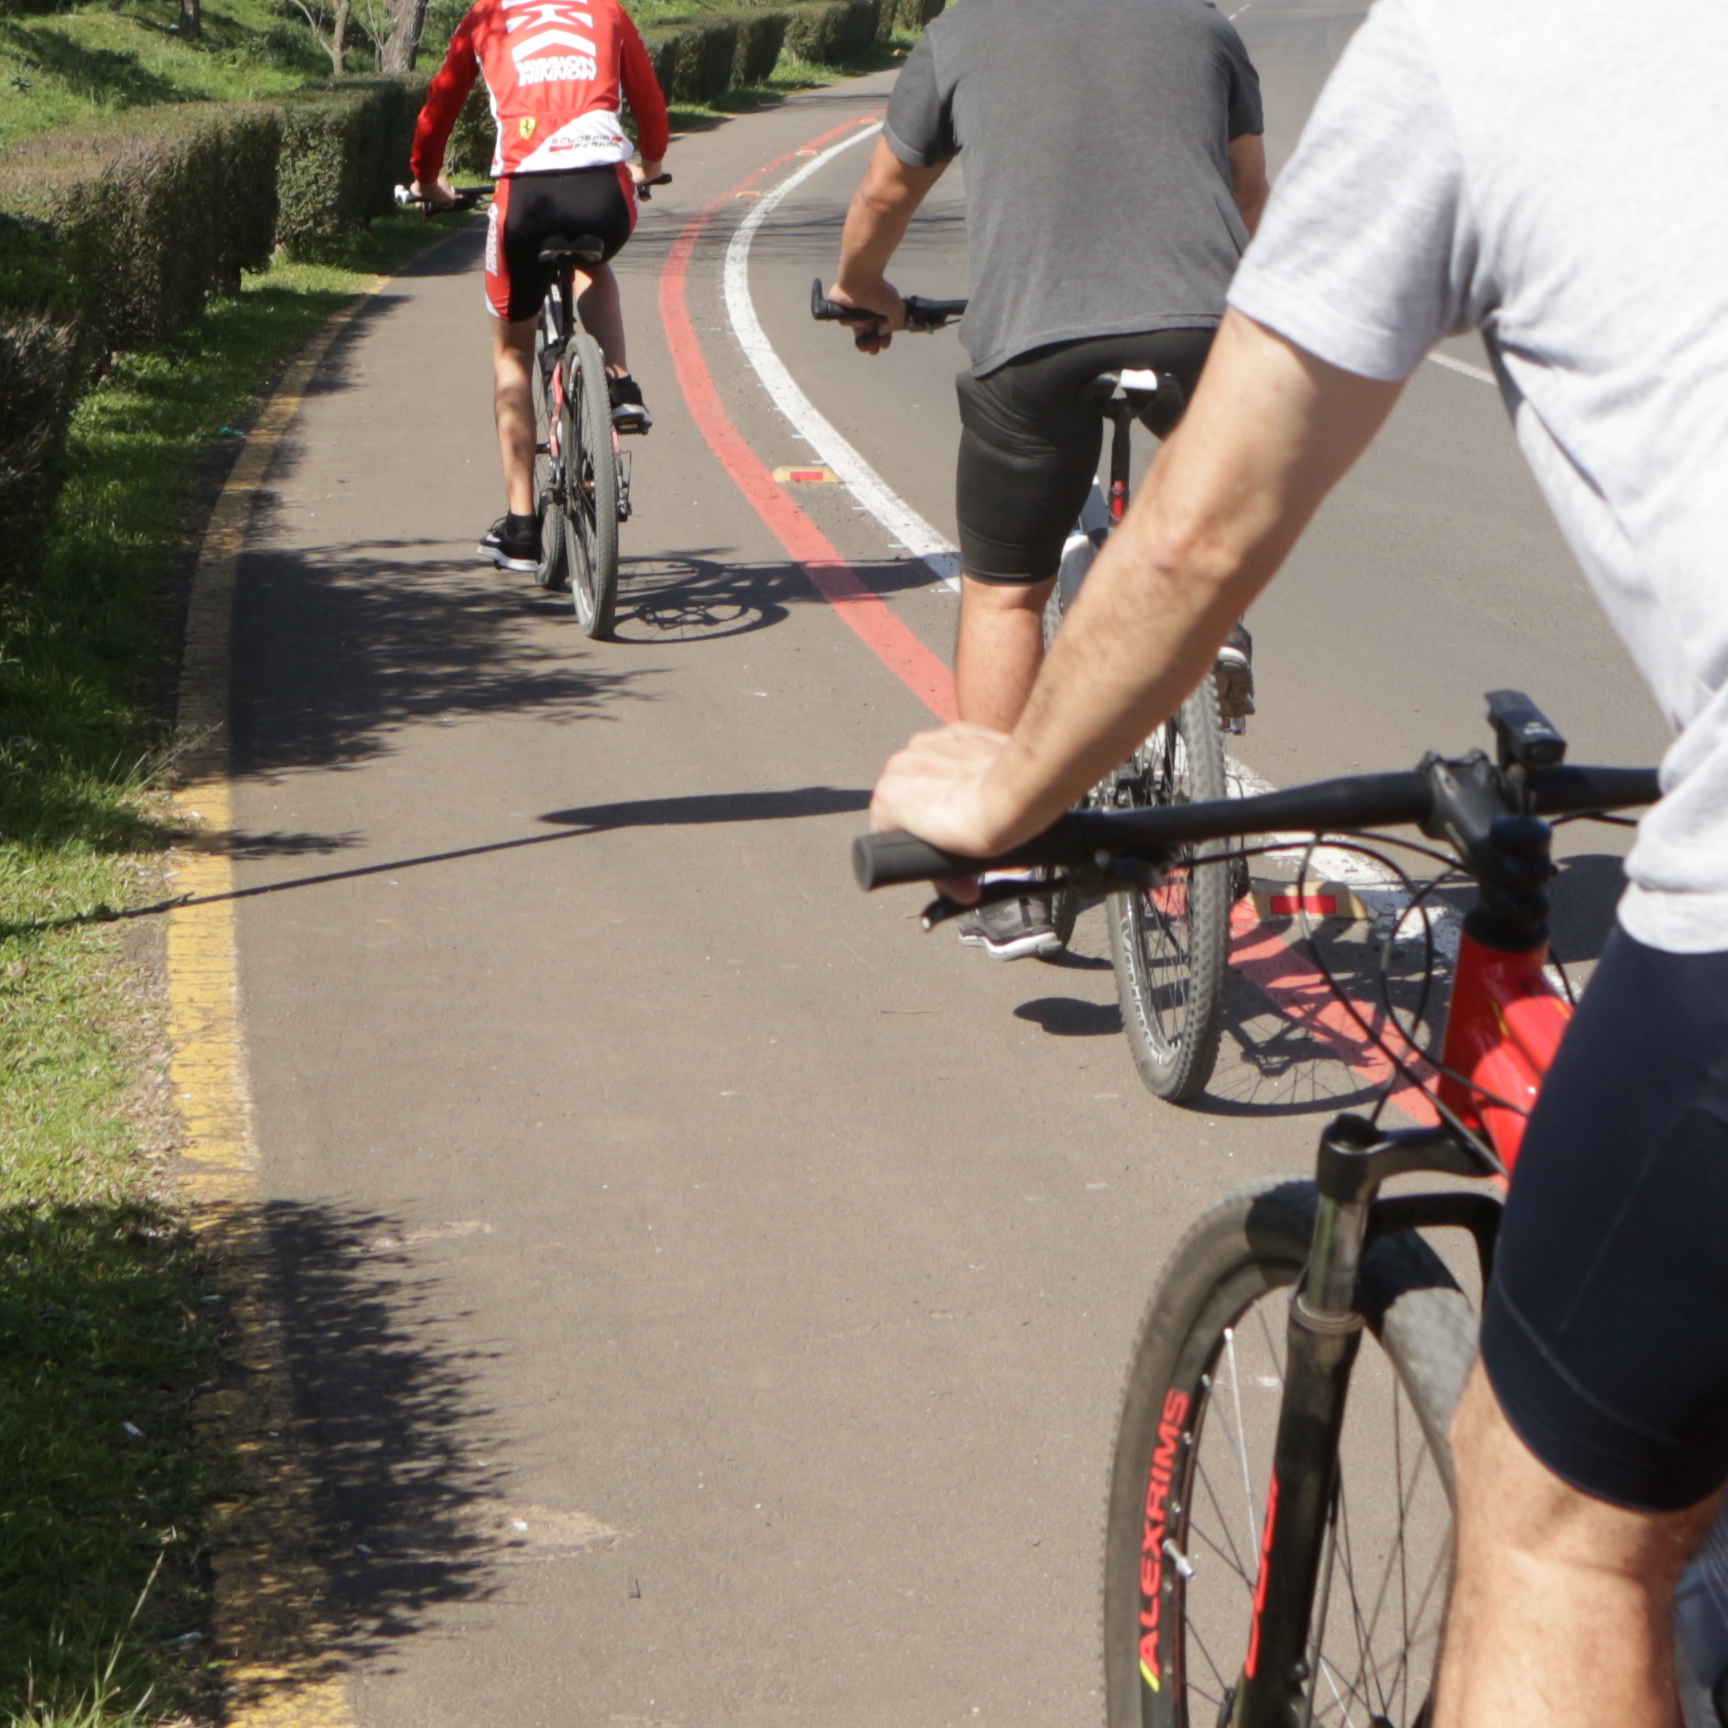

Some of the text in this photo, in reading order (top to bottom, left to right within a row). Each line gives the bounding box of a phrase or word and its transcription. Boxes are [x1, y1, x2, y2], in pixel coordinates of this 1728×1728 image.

[515, 55, 598, 72] MISSION
[518, 67, 598, 87] WINNOW
[1139, 1388, 1191, 1682] ALEXRIMS
